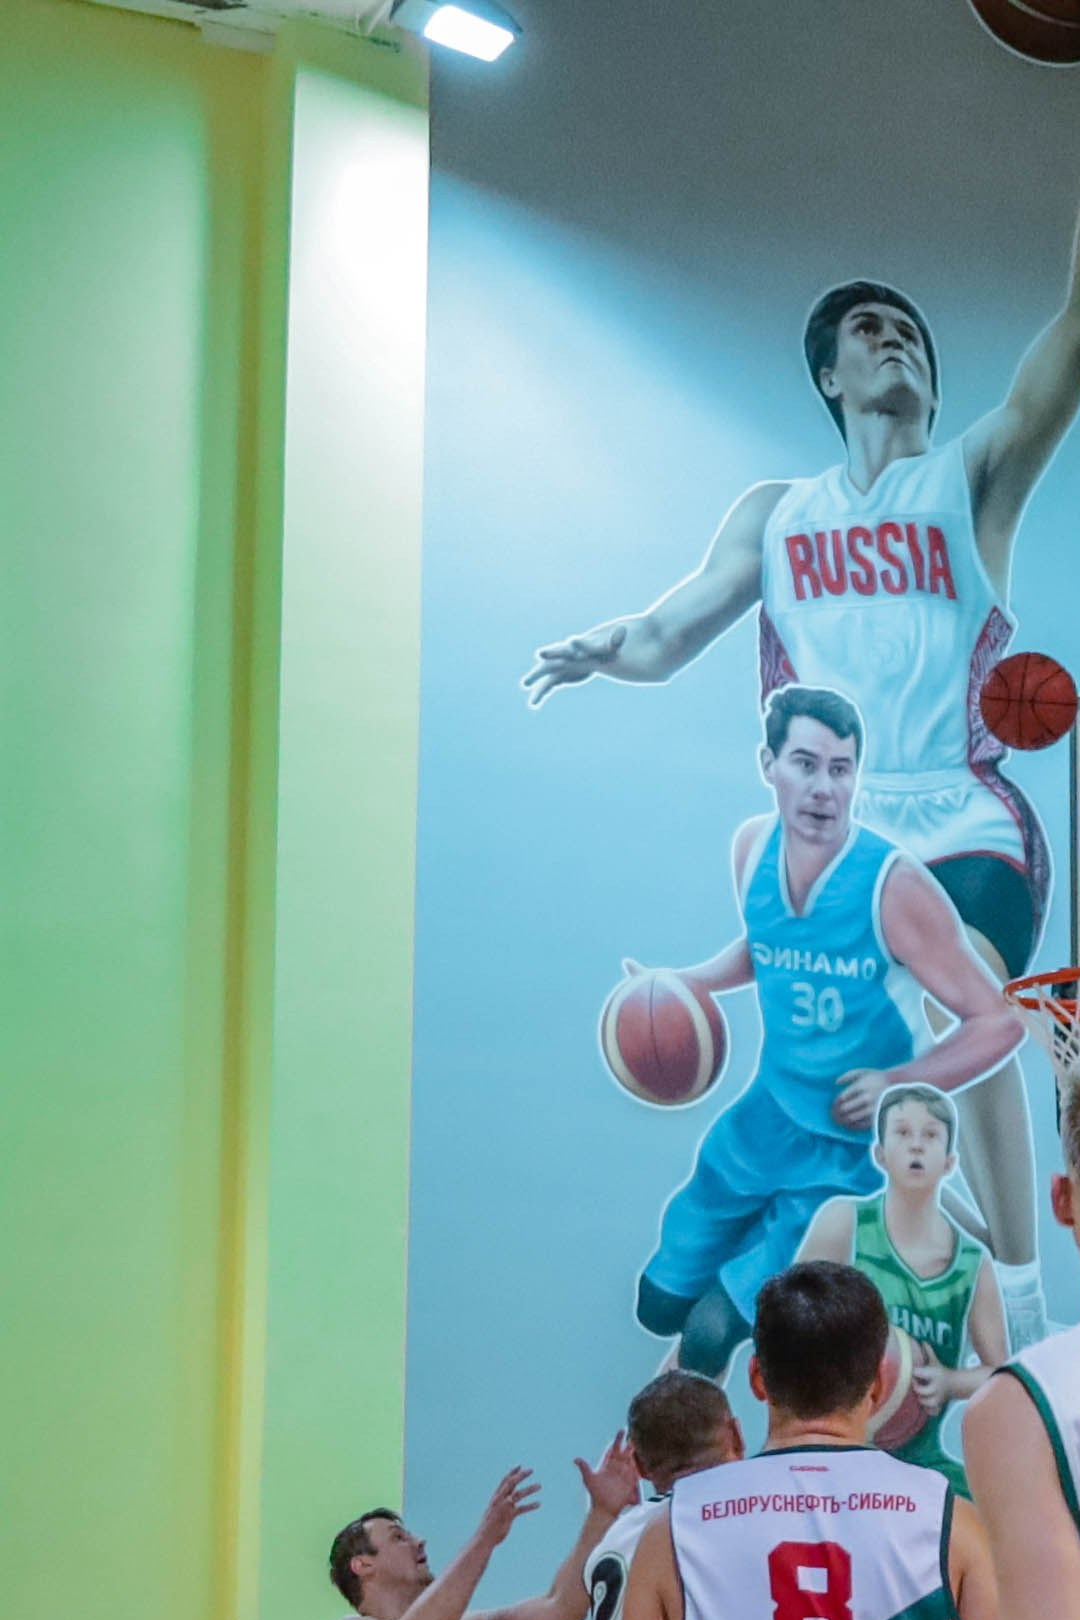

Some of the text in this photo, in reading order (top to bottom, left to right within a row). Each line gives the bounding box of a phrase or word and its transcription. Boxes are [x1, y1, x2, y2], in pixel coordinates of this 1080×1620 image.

[785, 521, 957, 601] RUSSIA
[753, 942, 877, 981] ДИНАМО
[791, 982, 845, 1033] 30
[701, 1493, 917, 1521] БЕЛОРУСНЕФТЬ-СИБИРЬ
